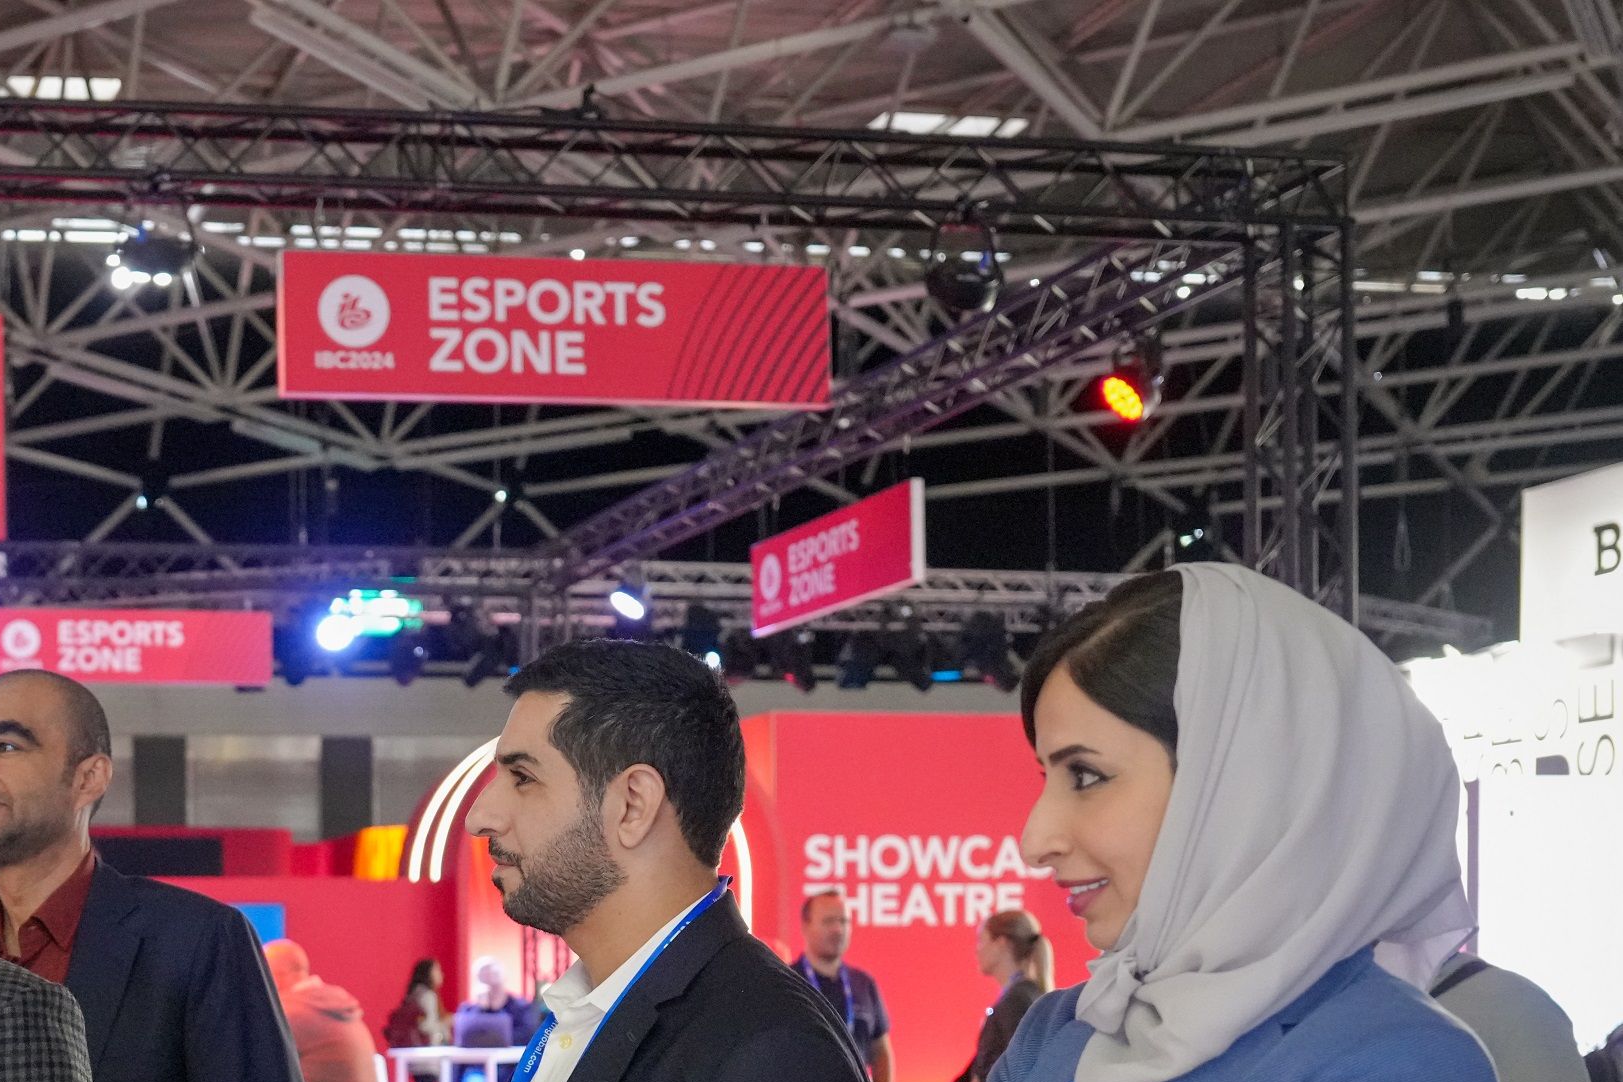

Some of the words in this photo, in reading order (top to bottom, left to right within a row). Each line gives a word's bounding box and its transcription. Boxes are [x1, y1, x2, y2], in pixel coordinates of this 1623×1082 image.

[428, 276, 666, 328] ESPORTS
[314, 350, 396, 370] IBC2024
[428, 328, 587, 375] ZONE
[787, 518, 860, 574] ESPORTS
[788, 561, 836, 607] ZONE
[57, 619, 185, 647] ESPORTS
[57, 646, 142, 673] ZONE
[804, 834, 1053, 879] SHOWCA
